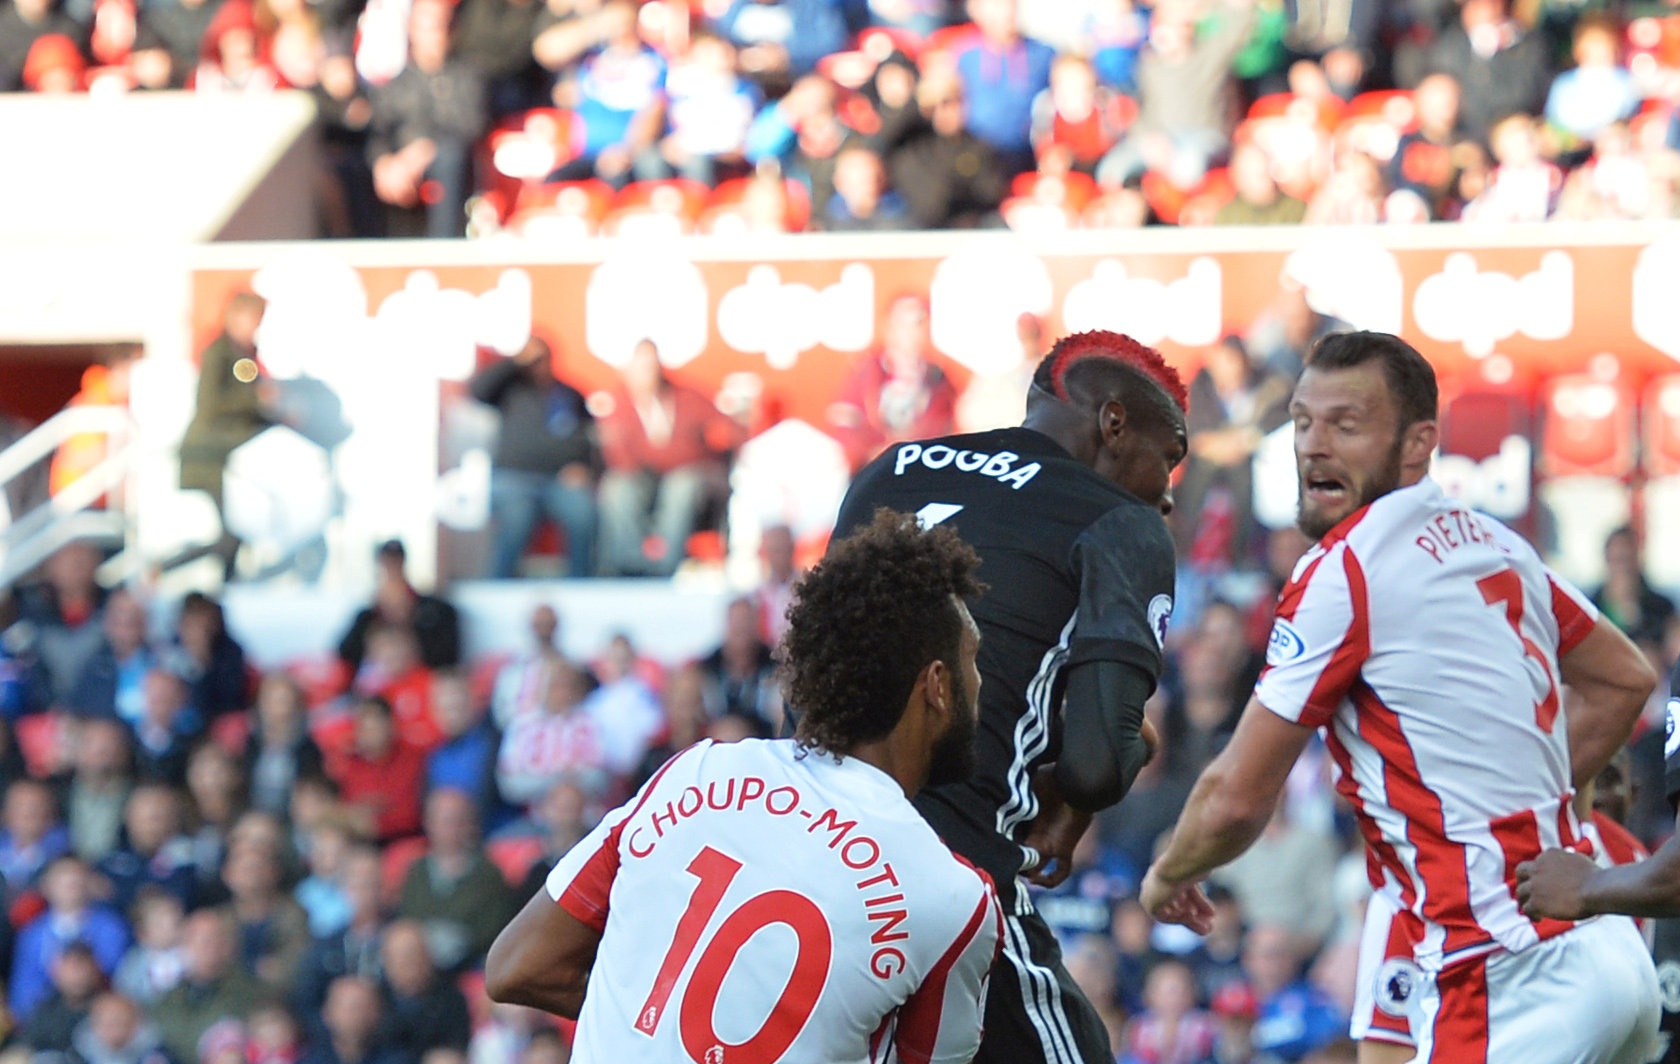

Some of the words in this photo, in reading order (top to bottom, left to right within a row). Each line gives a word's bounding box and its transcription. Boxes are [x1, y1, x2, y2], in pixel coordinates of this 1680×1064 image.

[717, 262, 875, 370] dpd
[1412, 250, 1574, 359] dpd
[894, 443, 1042, 490] POGBA
[627, 776, 910, 981] CHOUPO-MOTING
